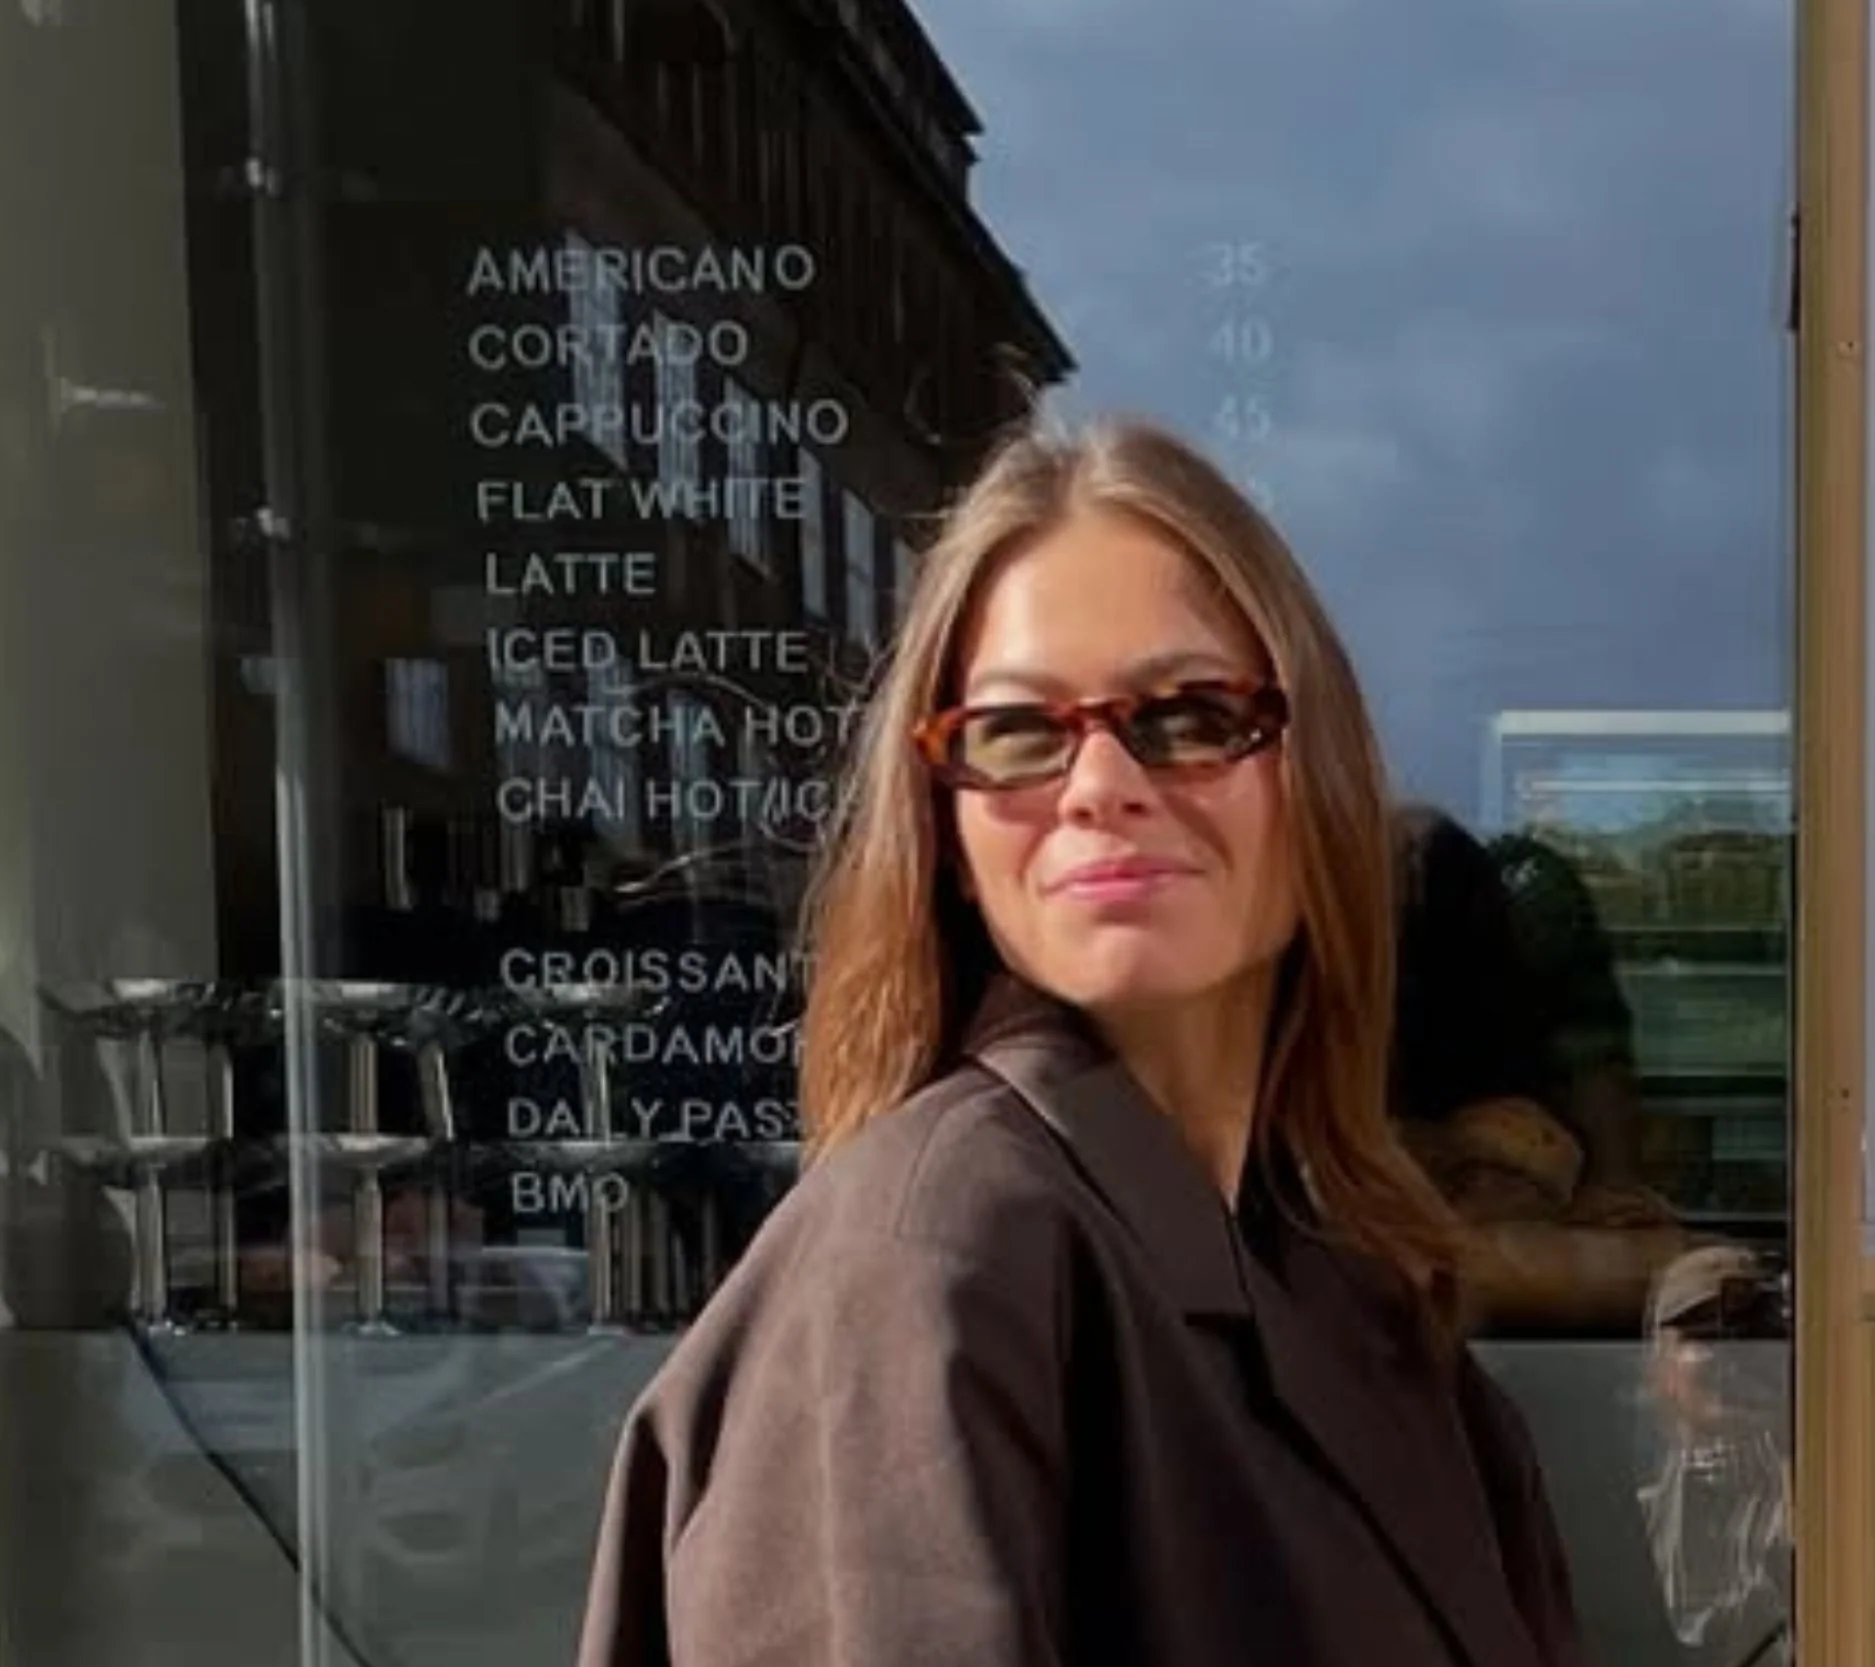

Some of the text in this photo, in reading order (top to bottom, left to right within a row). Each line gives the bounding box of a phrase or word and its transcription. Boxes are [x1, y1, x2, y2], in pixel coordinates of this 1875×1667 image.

[467, 245, 816, 296] AMERICANO
[468, 320, 749, 369] CORTADO
[470, 399, 850, 448] CAPPUCCINO
[476, 477, 805, 522] FLAT WHITE
[486, 552, 656, 596] LATTE
[487, 629, 809, 672] ICED LATTE
[494, 704, 726, 748] MATCHA
[496, 776, 832, 823] CHAI HOT/IC
[505, 1024, 806, 1066] CARDAMO
[508, 1097, 801, 1140] DAILY PAS
[511, 1171, 630, 1214] BMO
